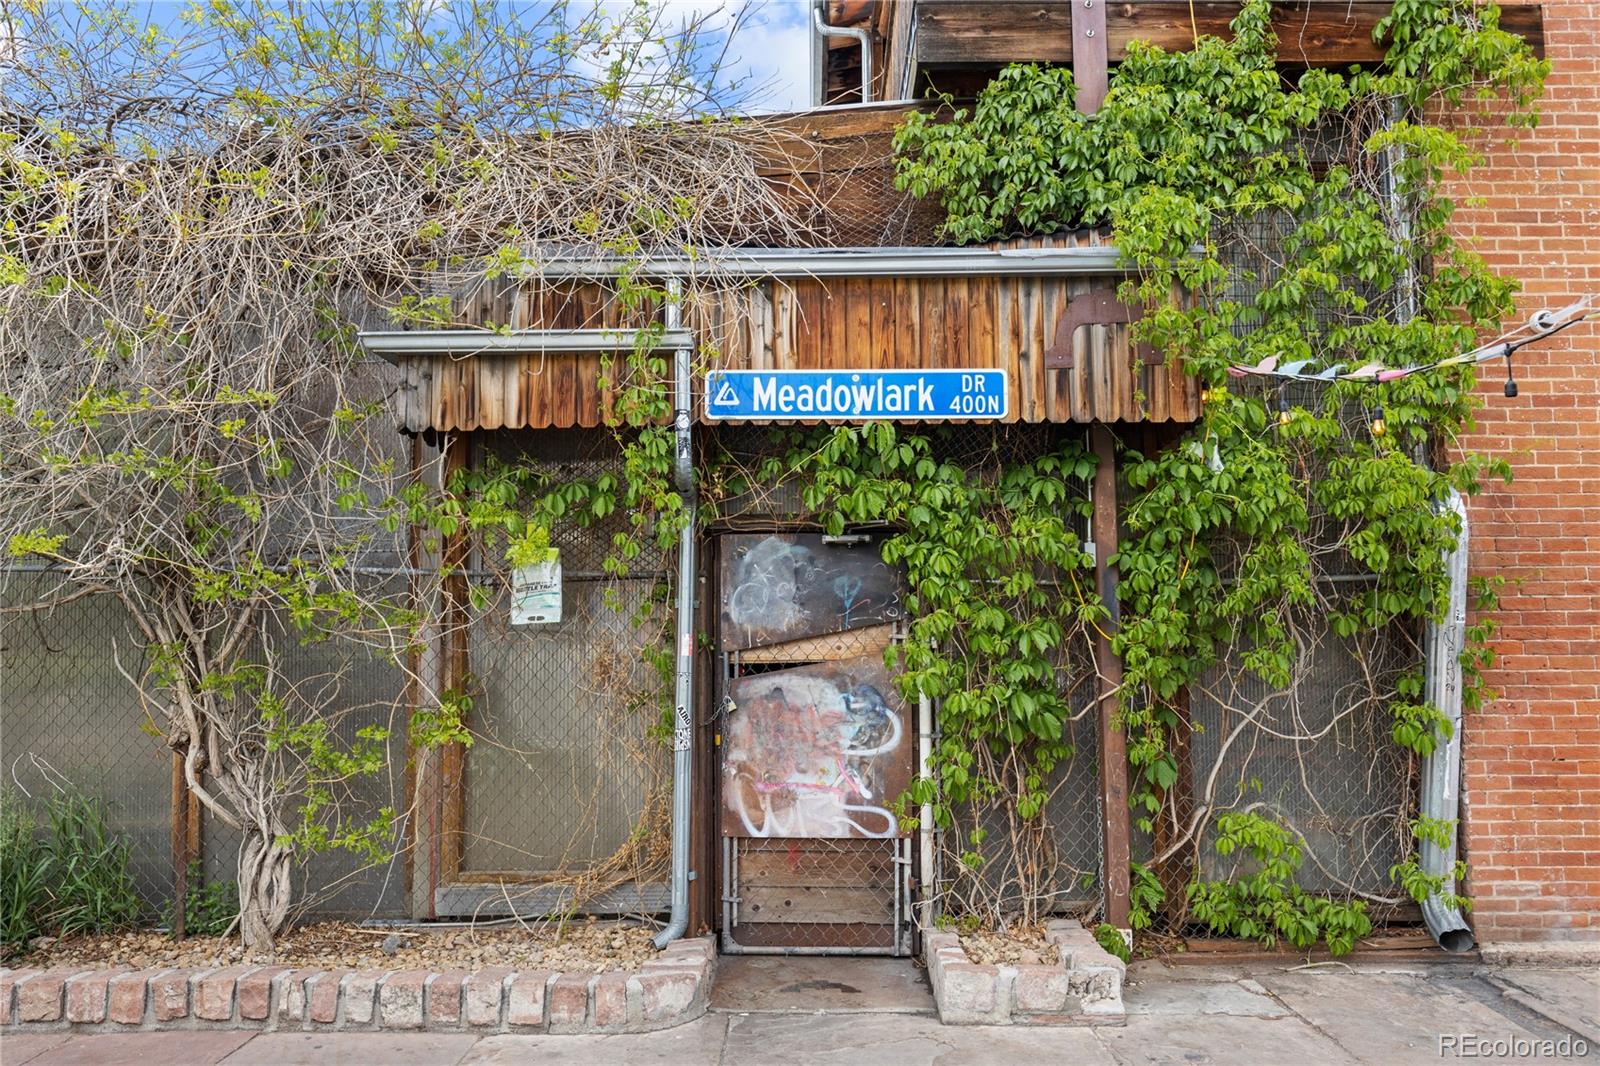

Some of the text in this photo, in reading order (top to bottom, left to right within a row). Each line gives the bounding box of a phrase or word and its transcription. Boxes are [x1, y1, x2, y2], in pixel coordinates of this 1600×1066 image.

[962, 374, 985, 393] DR
[753, 376, 934, 412] Meadowlark
[949, 395, 999, 414] 400N
